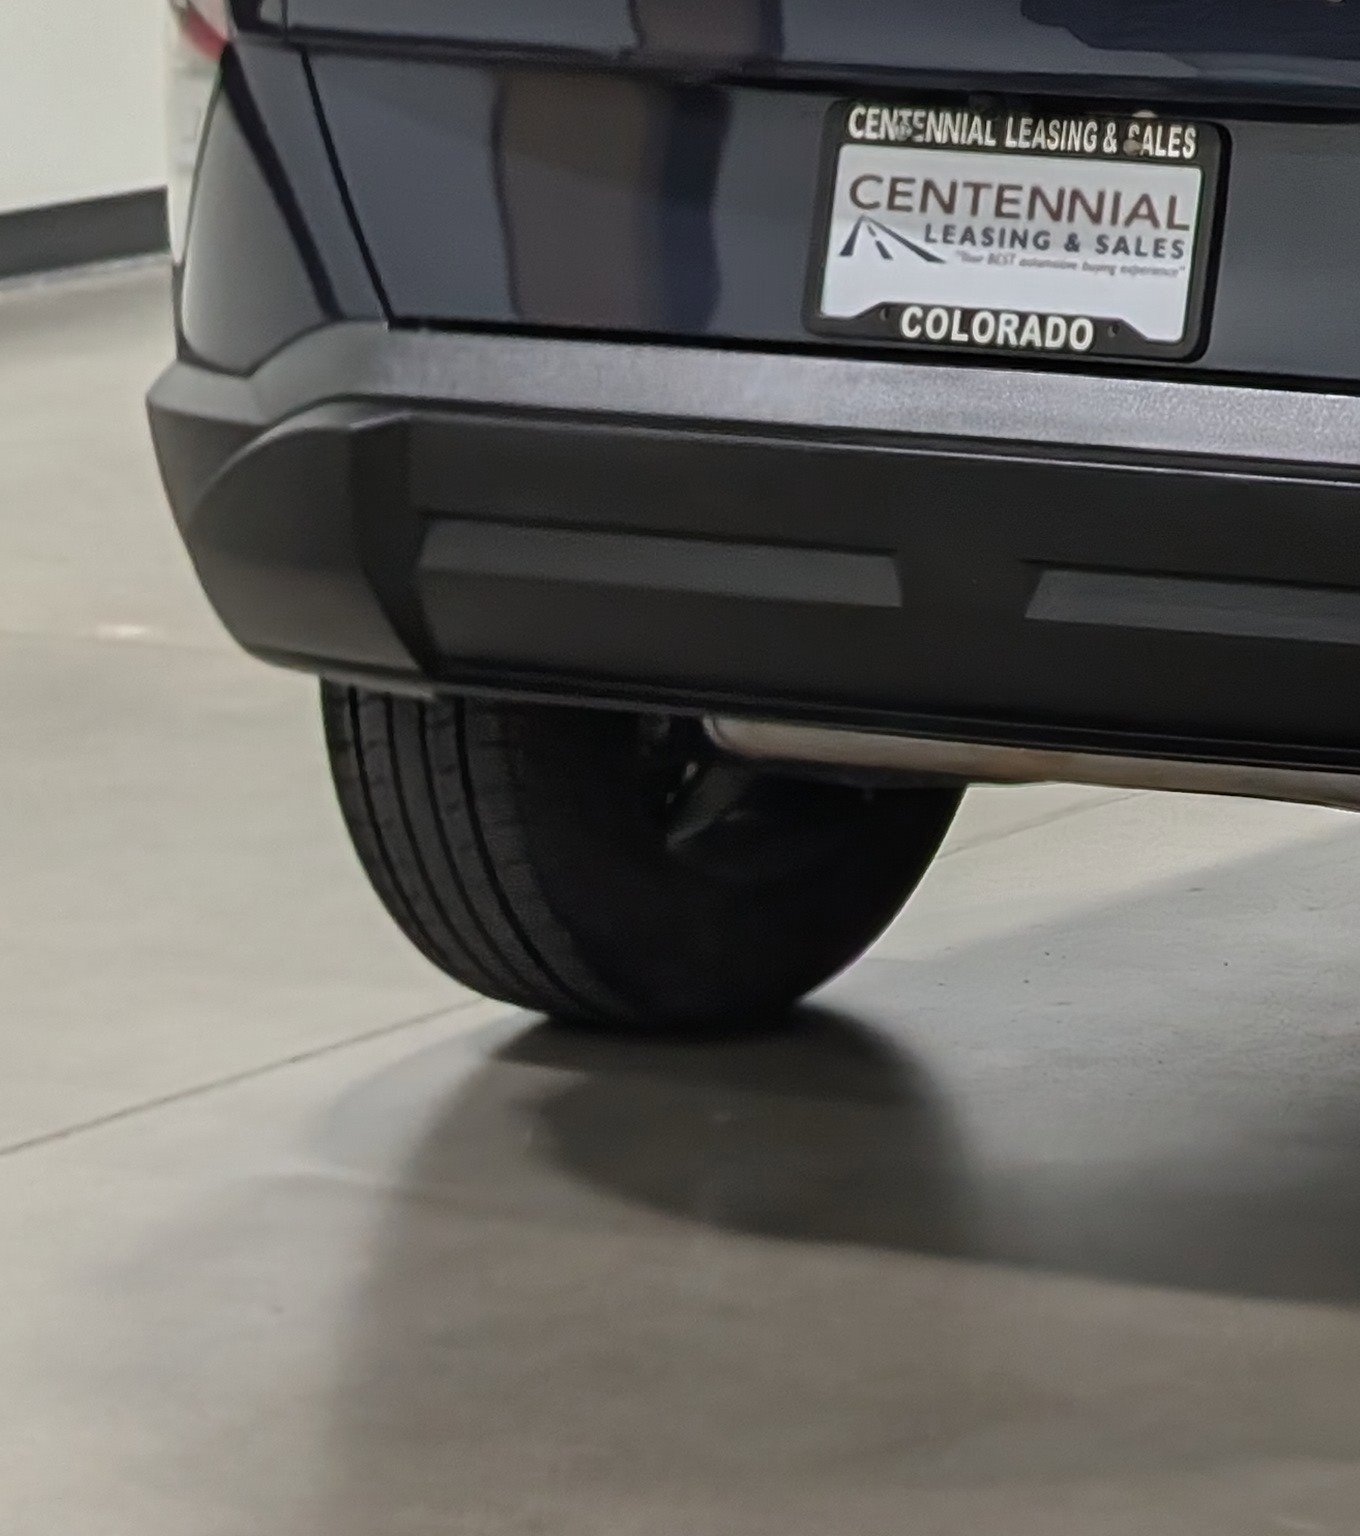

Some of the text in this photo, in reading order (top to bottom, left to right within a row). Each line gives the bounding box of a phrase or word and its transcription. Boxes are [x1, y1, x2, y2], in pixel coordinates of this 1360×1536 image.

[848, 105, 997, 147] CENTENNIAL
[1005, 117, 1098, 153] LEASING
[1102, 122, 1118, 154] &
[850, 174, 1190, 231] CENTENNIAL
[924, 224, 1186, 260] LEASING & SALES
[901, 306, 1094, 351] COLORADO
